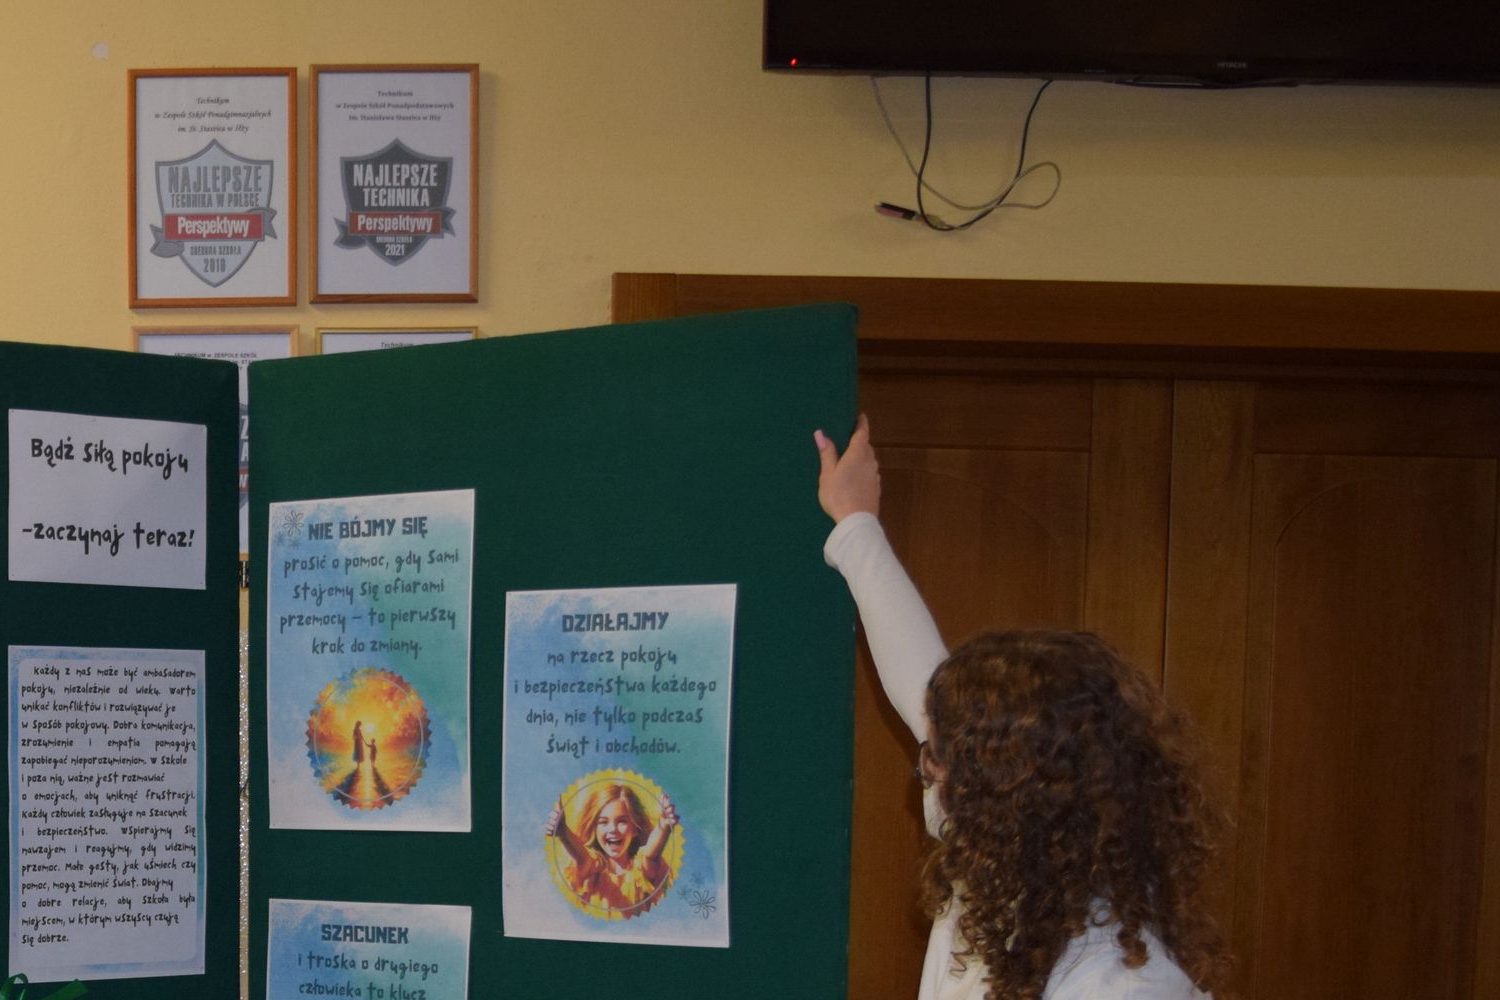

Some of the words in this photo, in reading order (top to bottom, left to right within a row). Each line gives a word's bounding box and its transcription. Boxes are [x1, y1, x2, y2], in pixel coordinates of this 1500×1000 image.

[353, 164, 438, 186] NAJLEPSZE
[171, 194, 212, 208] TECHNIKA
[363, 188, 430, 206] TECHNIKA
[177, 216, 250, 238] Perspektywy
[357, 215, 433, 233] Perspektywy
[385, 244, 405, 256] 2021
[30, 437, 74, 467] Bądź
[121, 443, 188, 480] pokoju
[132, 522, 194, 548] teraz!
[308, 522, 333, 540] NIE
[339, 516, 396, 538] BÓJMY
[401, 516, 428, 538] SIĘ
[283, 555, 326, 578] prosić
[344, 556, 389, 575] pomoc,
[394, 550, 421, 573] gdy
[384, 577, 444, 594] ofiarami
[279, 614, 346, 634] przemocy
[367, 608, 385, 626] to
[390, 607, 456, 630] pierwszy
[561, 612, 669, 632] DZIAŁAJMY
[311, 637, 344, 654] krok
[350, 638, 365, 652] do
[369, 639, 422, 659] zmiany.
[570, 649, 614, 664] rzecz
[620, 645, 677, 671] pokoju
[524, 676, 645, 701] bezpieczeństwa
[651, 675, 716, 700] każdego
[525, 709, 558, 725] dnia,
[564, 709, 586, 725] nie
[592, 706, 636, 732] tylko
[641, 708, 703, 730] podczas
[545, 734, 589, 759] świąt
[605, 736, 680, 755] obchodów.
[321, 924, 408, 944] SZACUNEK
[306, 951, 356, 969] troska
[374, 957, 438, 980] drugiego
[298, 979, 361, 997] człowieka
[366, 982, 383, 1000] to
